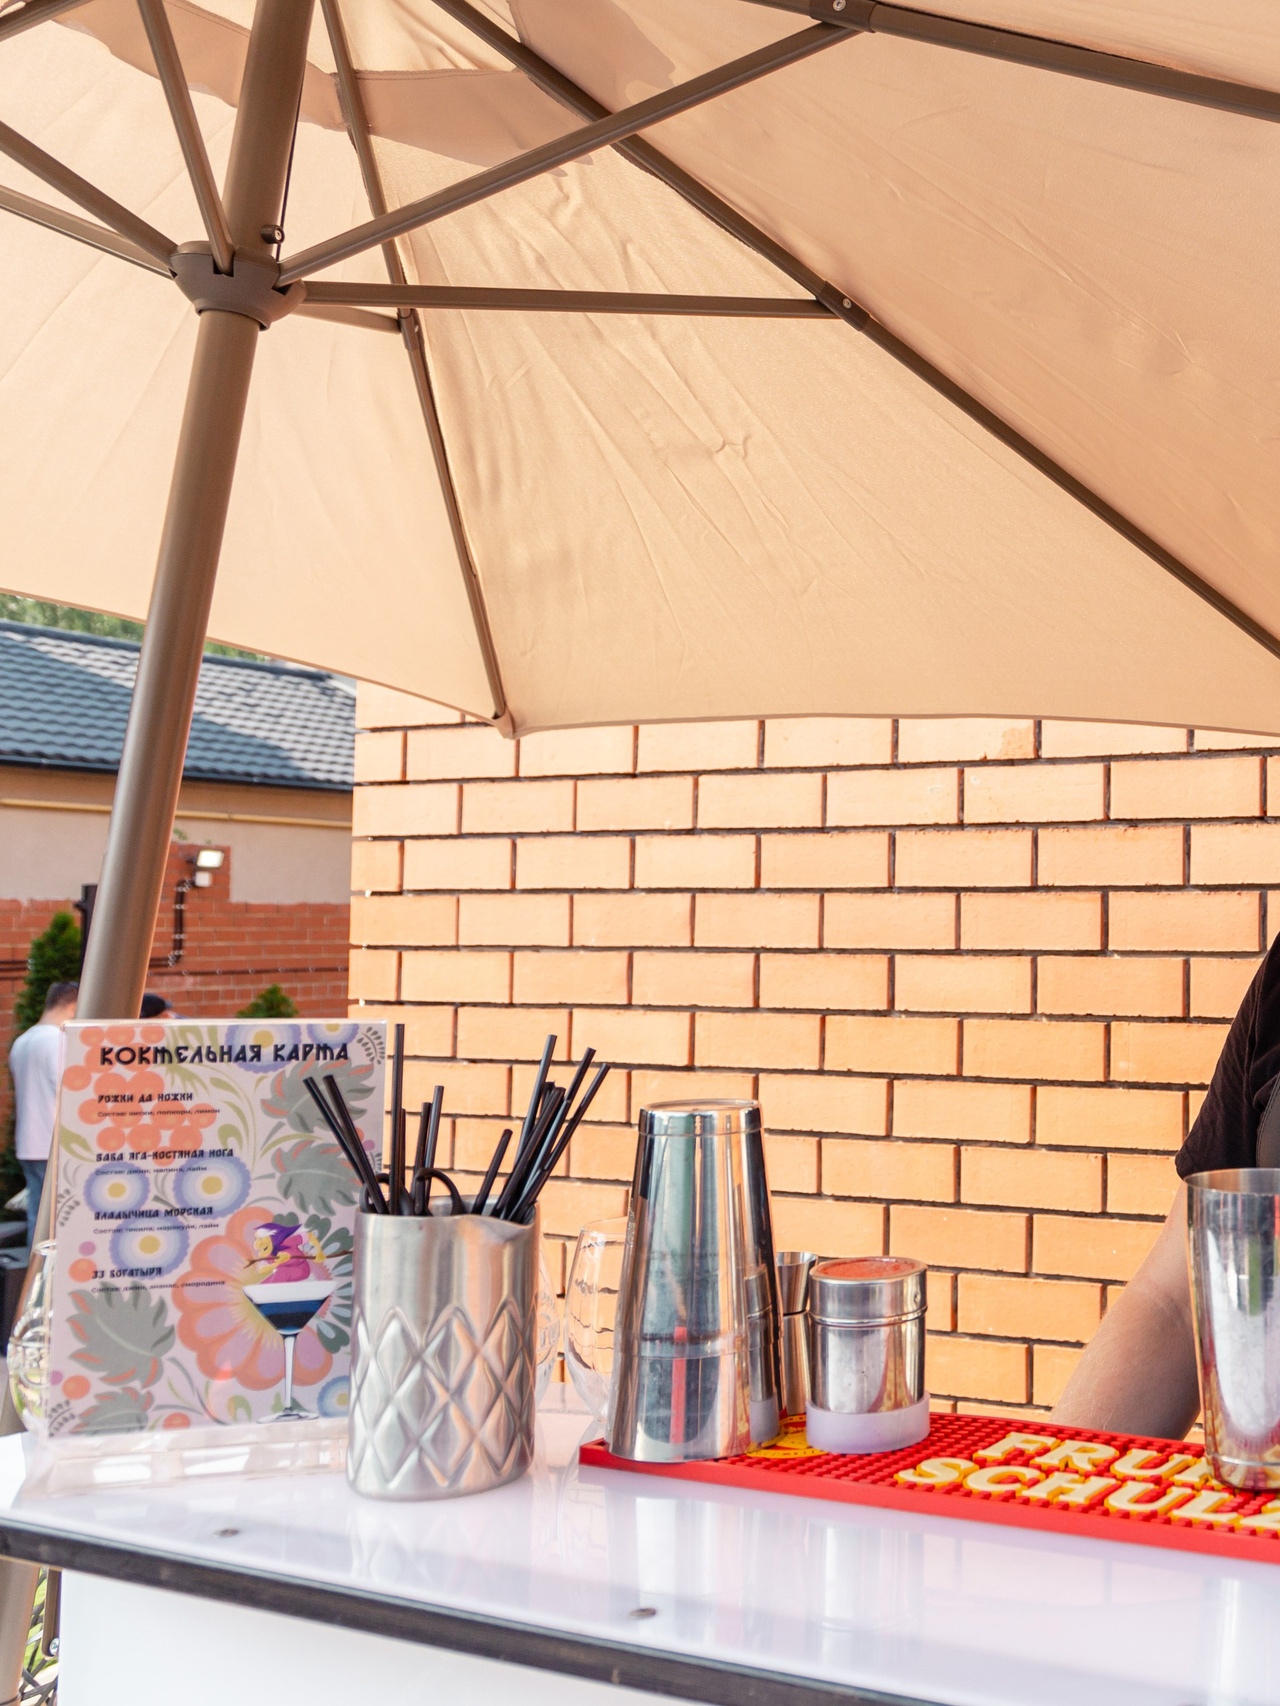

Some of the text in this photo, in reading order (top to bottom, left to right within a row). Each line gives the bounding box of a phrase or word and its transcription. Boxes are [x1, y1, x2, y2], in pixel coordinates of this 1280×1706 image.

[100, 1043, 349, 1066] КОКТЕЛЬНАЯ КАРТА
[97, 1092, 193, 1104] РОЖКИ ДА НОЖКИ
[96, 1153, 124, 1162] БАБА
[209, 1148, 234, 1158] НОГА
[164, 1206, 213, 1218] МОРСКАЯ
[92, 1266, 162, 1280] 33 БОГАТЫРЯ
